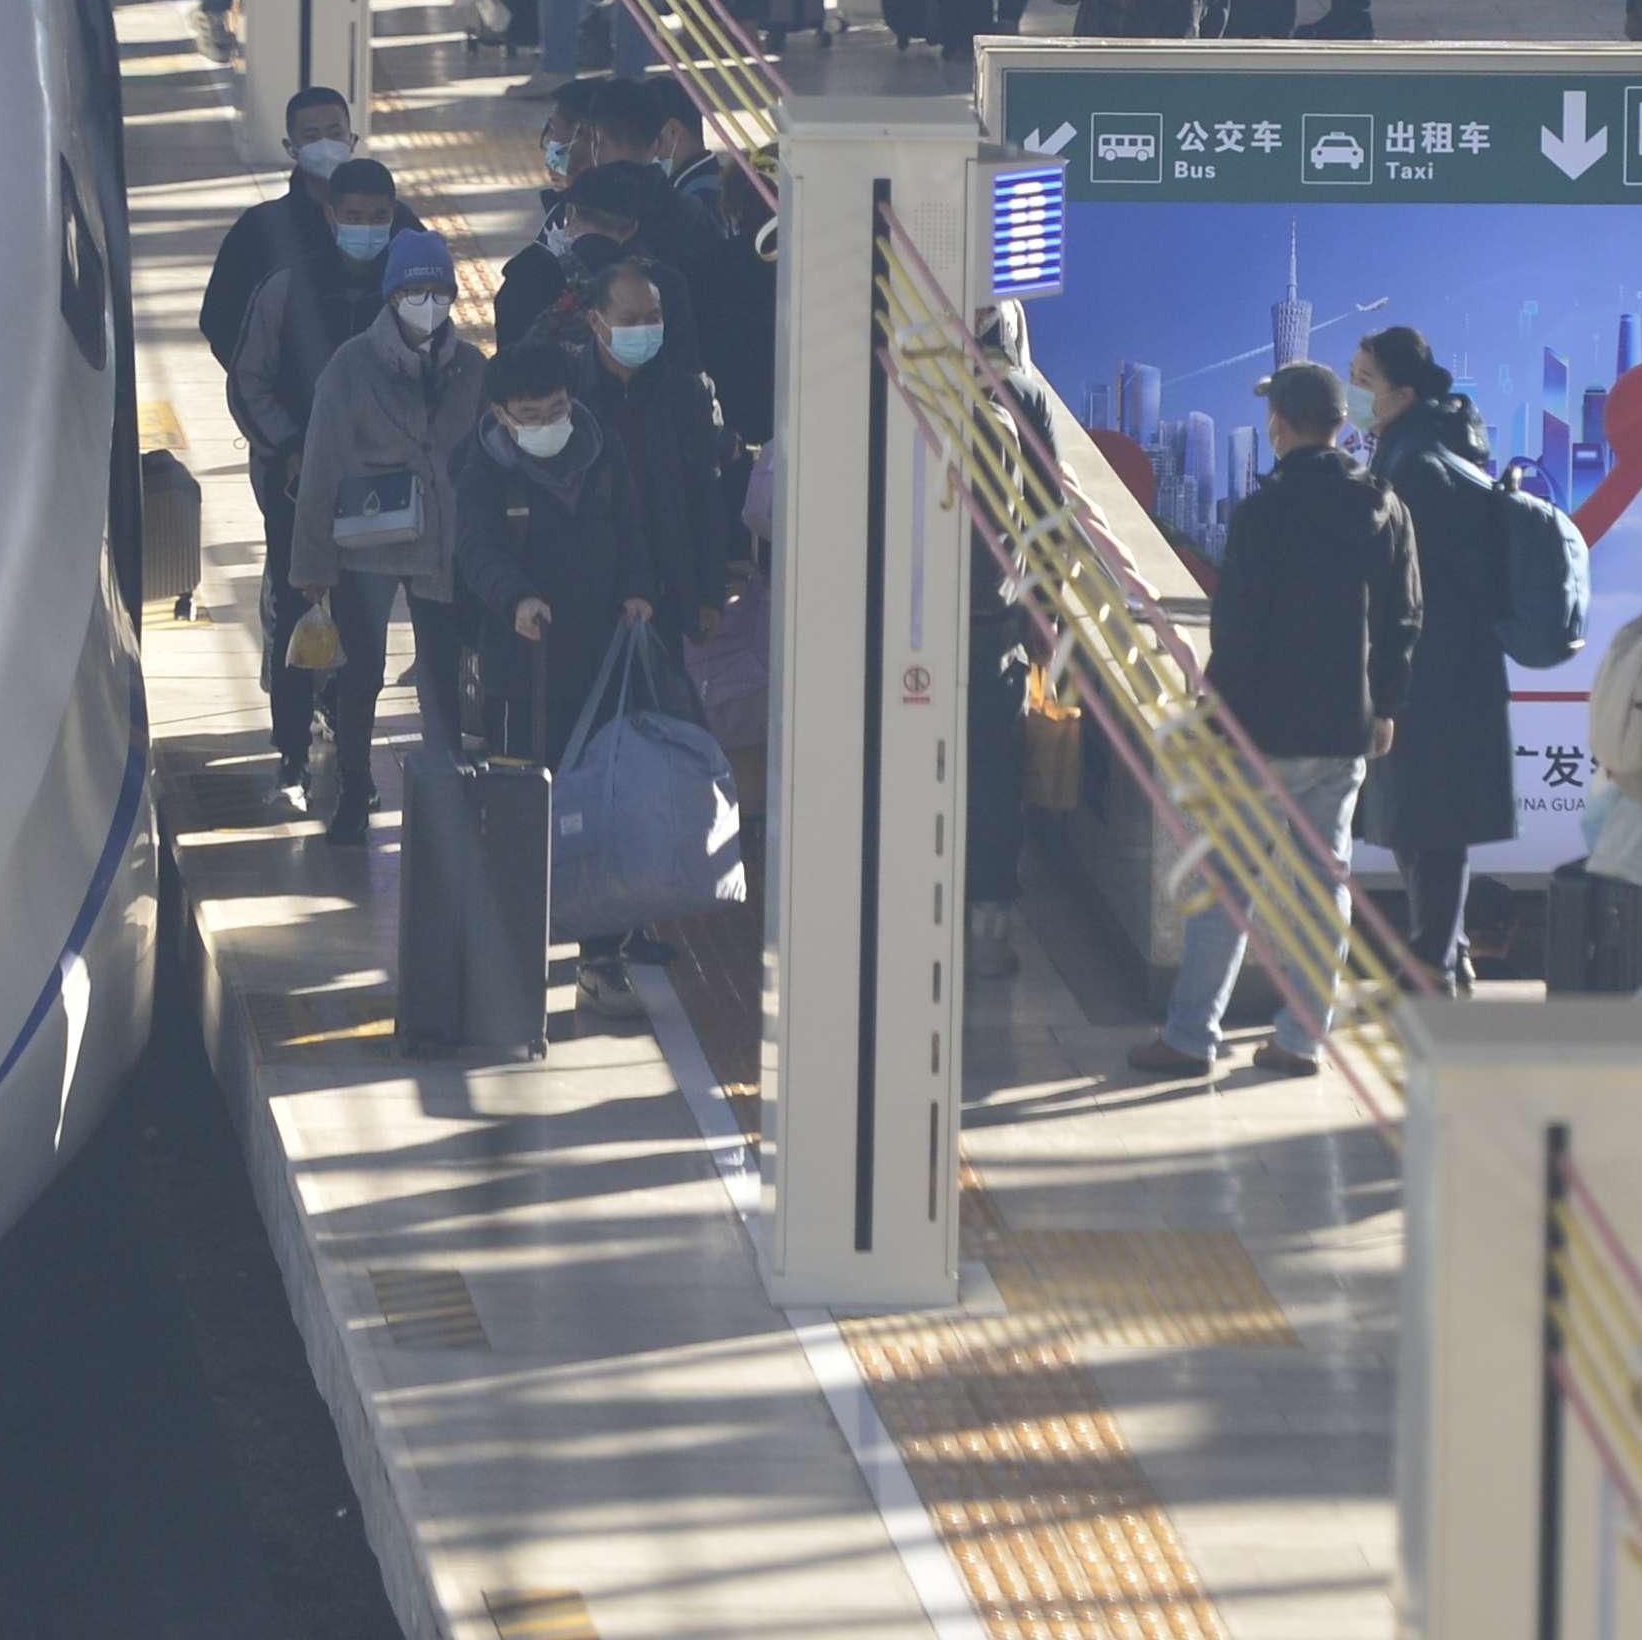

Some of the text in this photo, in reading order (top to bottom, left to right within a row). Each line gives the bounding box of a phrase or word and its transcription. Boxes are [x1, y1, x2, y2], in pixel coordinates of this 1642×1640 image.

[1175, 120, 1283, 154] 公交车
[1385, 120, 1492, 155] 出租车
[1174, 161, 1216, 179] Bus
[1385, 161, 1434, 180] Taxi
[1008, 181, 1048, 281] 8
